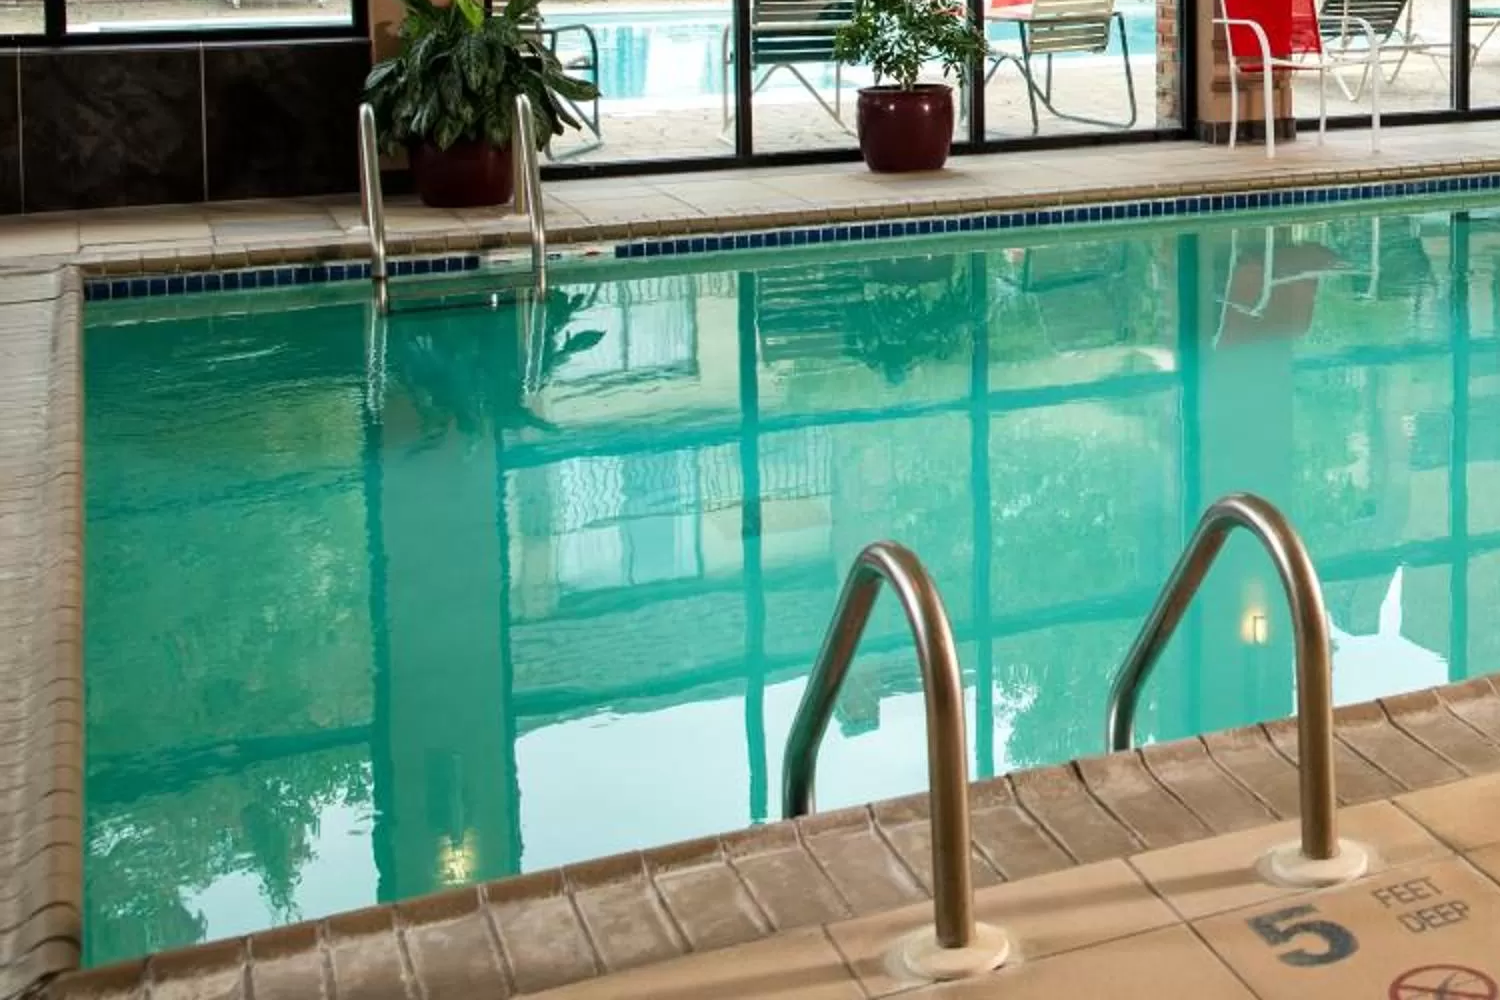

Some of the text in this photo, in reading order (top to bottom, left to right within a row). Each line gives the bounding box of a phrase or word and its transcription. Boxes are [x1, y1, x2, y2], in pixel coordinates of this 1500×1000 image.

[1372, 876, 1443, 908] FEET
[1397, 900, 1470, 933] DEEP
[1246, 904, 1360, 968] 5
